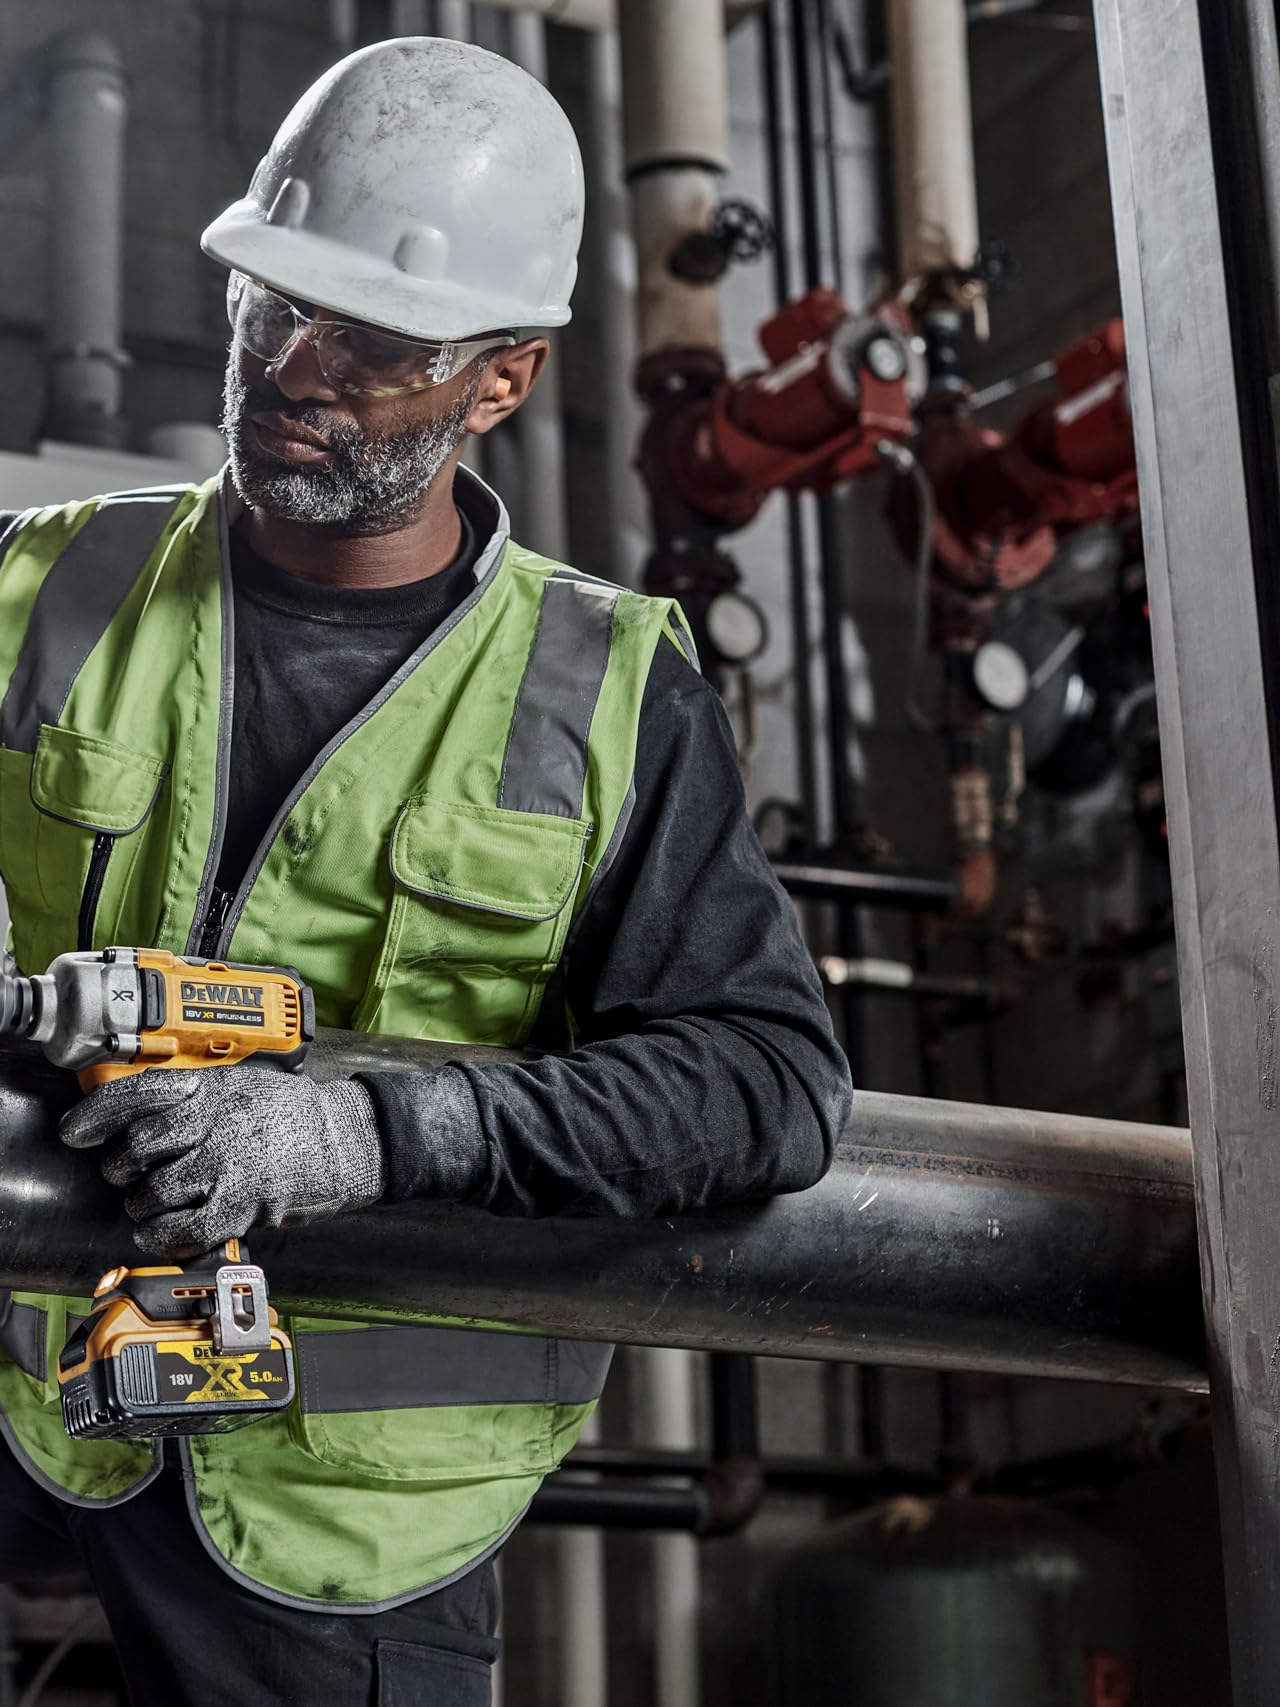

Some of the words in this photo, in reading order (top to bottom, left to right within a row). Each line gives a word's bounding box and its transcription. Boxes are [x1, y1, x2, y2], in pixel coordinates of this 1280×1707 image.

[112, 990, 135, 1002] XR
[185, 1009, 202, 1019] 18V
[202, 1011, 215, 1019] XR
[216, 1012, 262, 1022] BRUSHLESS
[169, 1373, 193, 1386] 18V
[200, 1360, 249, 1392] XR
